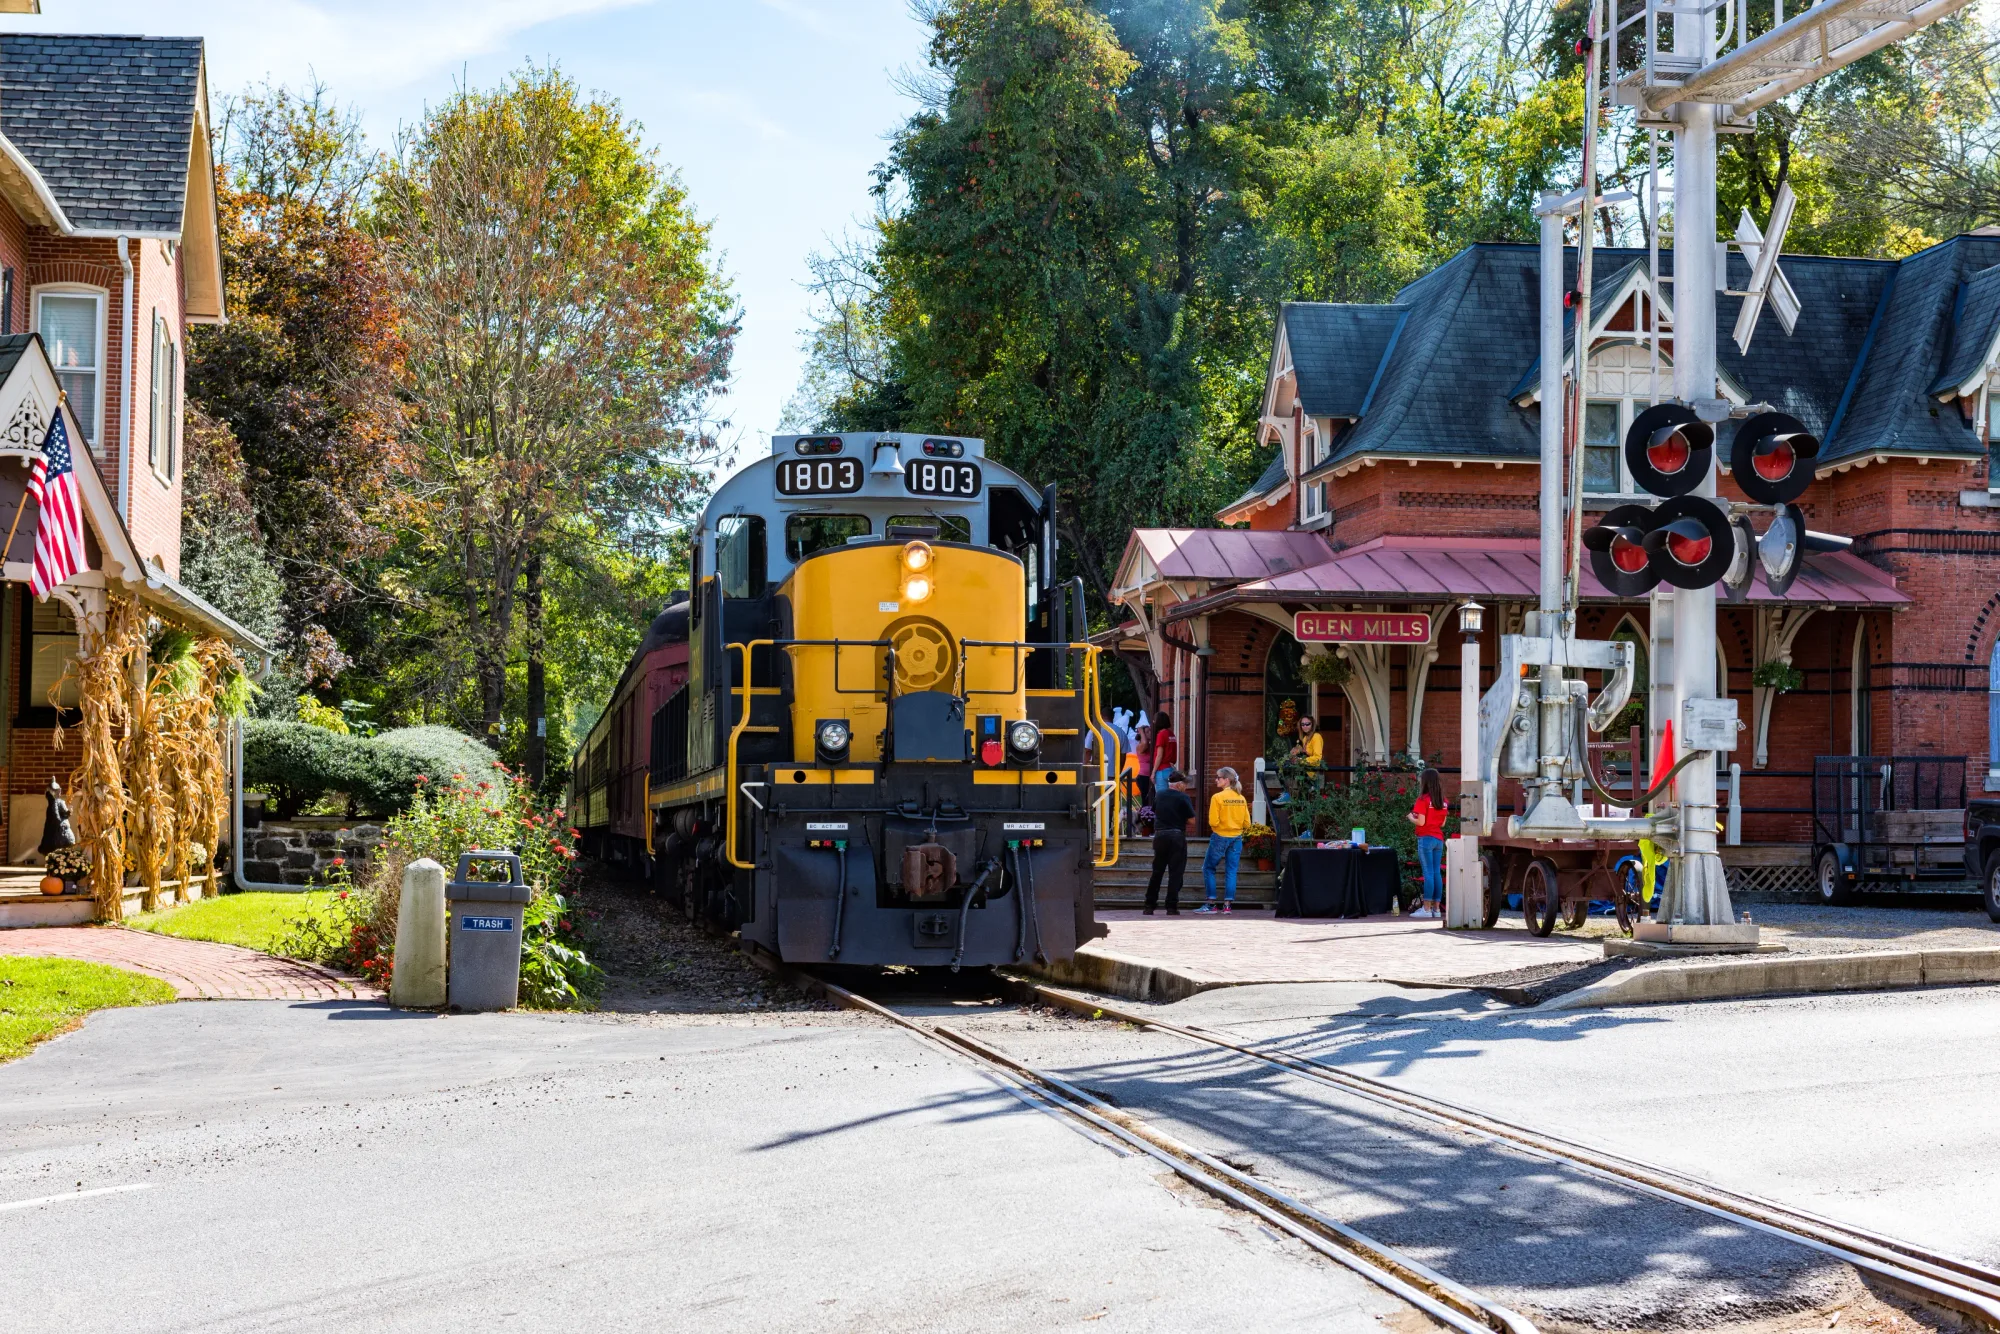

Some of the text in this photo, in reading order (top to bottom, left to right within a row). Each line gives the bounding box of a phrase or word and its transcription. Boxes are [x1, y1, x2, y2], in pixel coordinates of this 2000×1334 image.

[785, 462, 854, 491] 1803
[912, 464, 974, 494] 1803
[1302, 619, 1423, 637] GLEN MILLS
[472, 919, 503, 928] TRASH
